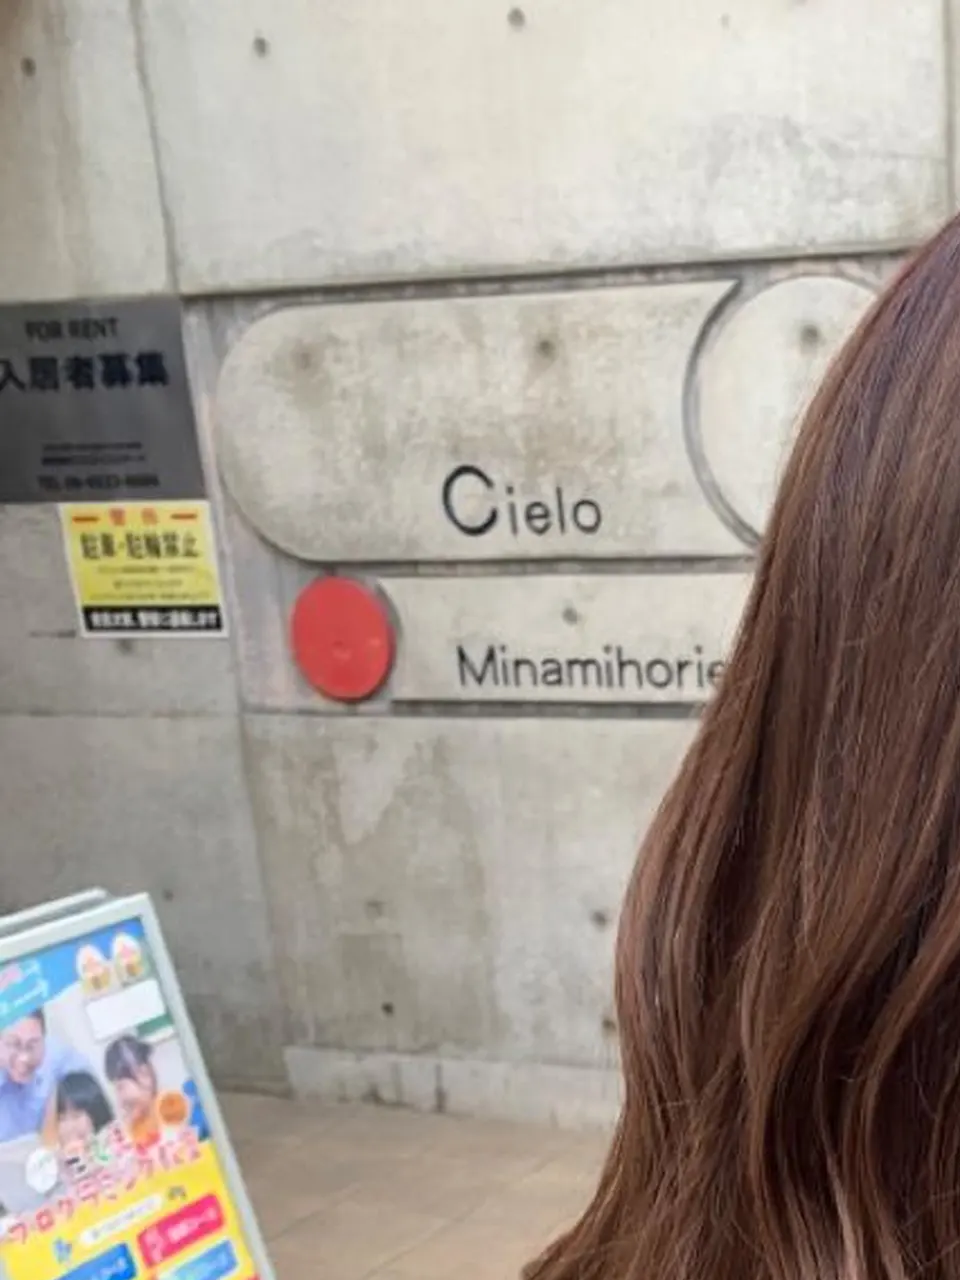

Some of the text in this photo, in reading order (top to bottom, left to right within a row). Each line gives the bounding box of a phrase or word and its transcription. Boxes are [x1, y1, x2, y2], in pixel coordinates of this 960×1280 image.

[26, 317, 119, 341] FOR RENT
[442, 465, 602, 536] Cielo
[456, 645, 724, 688] Minamihorie
